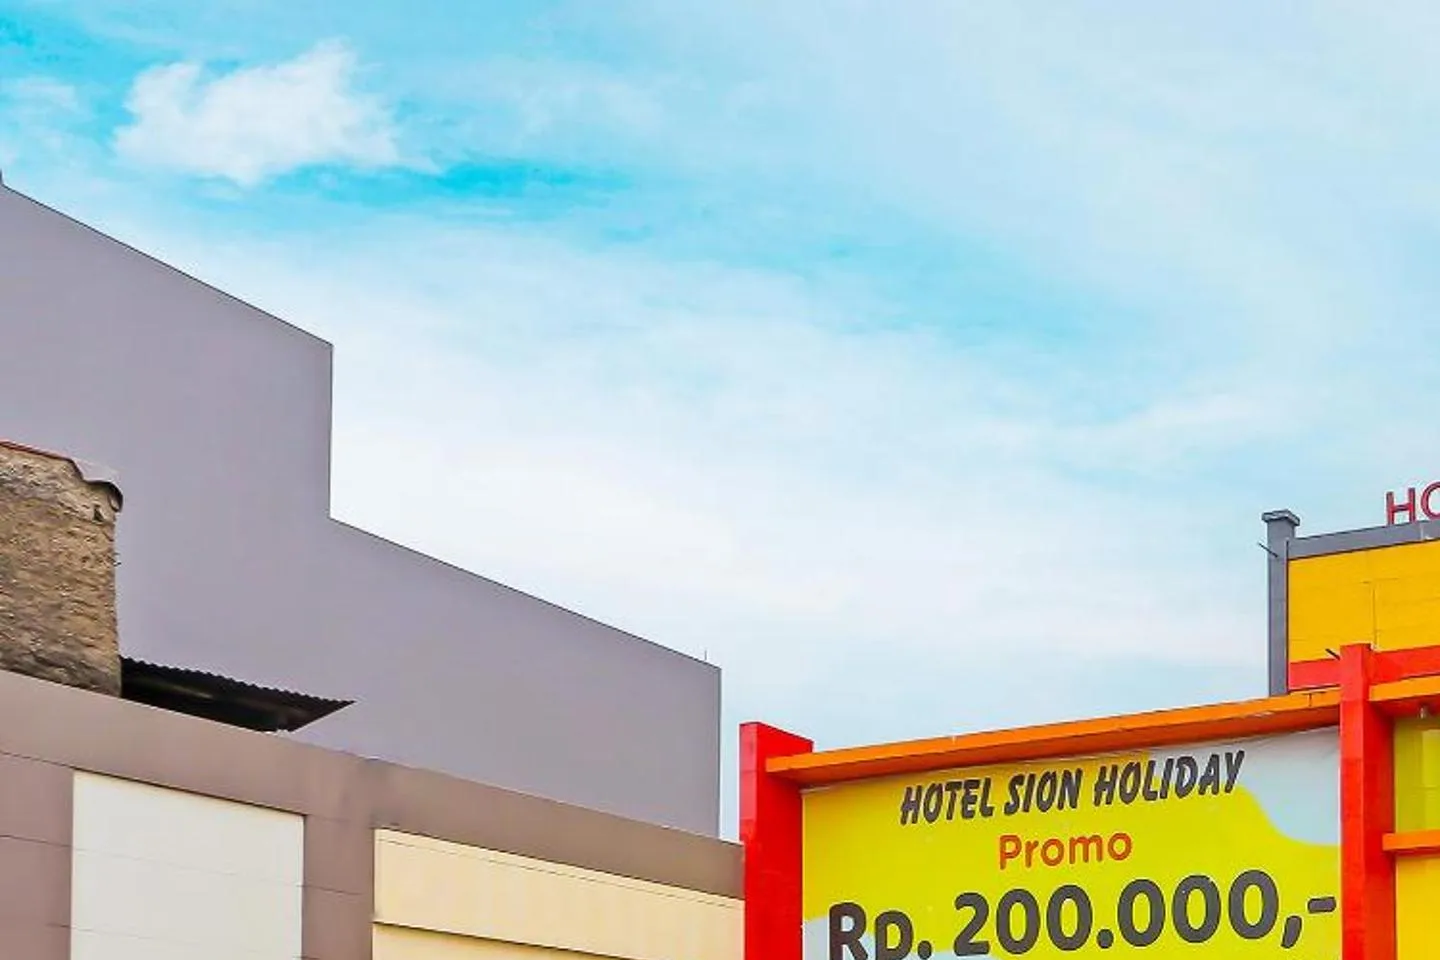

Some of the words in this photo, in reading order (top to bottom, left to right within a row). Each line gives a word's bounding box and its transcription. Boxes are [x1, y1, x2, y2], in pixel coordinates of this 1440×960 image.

[901, 778, 994, 825] HOTEL
[1004, 769, 1082, 815] SION
[1094, 751, 1245, 806] HOLIDAY
[1000, 833, 1133, 870] Promo
[953, 870, 1336, 956] 200.000,-
